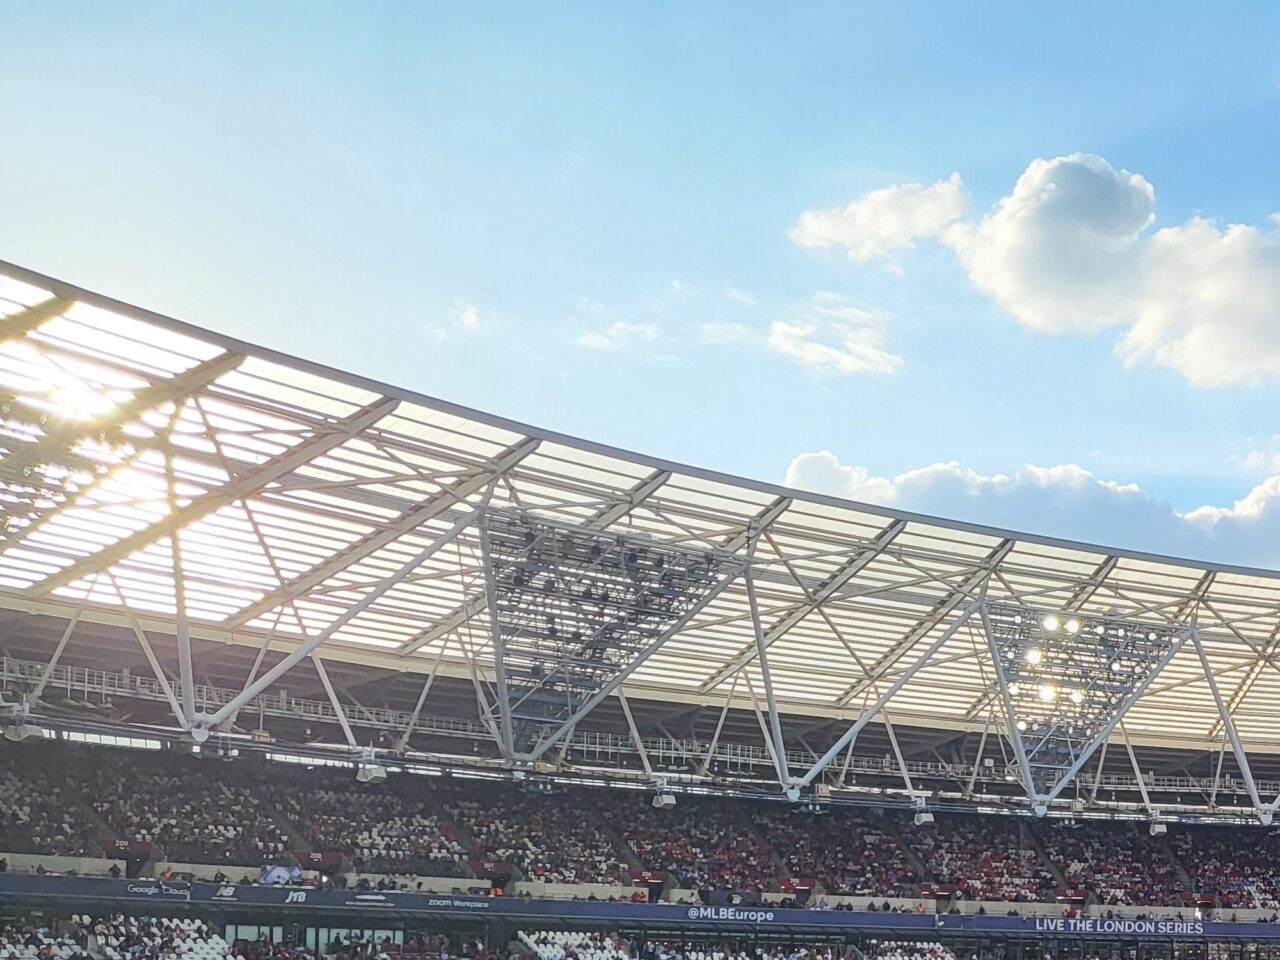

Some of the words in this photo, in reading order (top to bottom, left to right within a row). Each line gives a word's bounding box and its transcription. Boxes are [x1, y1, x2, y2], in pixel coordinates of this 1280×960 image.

[128, 884, 160, 896] Google
[284, 892, 306, 903] JTB
[452, 900, 490, 909] Workplace
[688, 908, 774, 922] @MLBEurope
[1036, 918, 1064, 931] LIVE
[1068, 920, 1093, 932] THE
[1096, 920, 1155, 933] LONDON
[1158, 922, 1204, 934] SERIES
